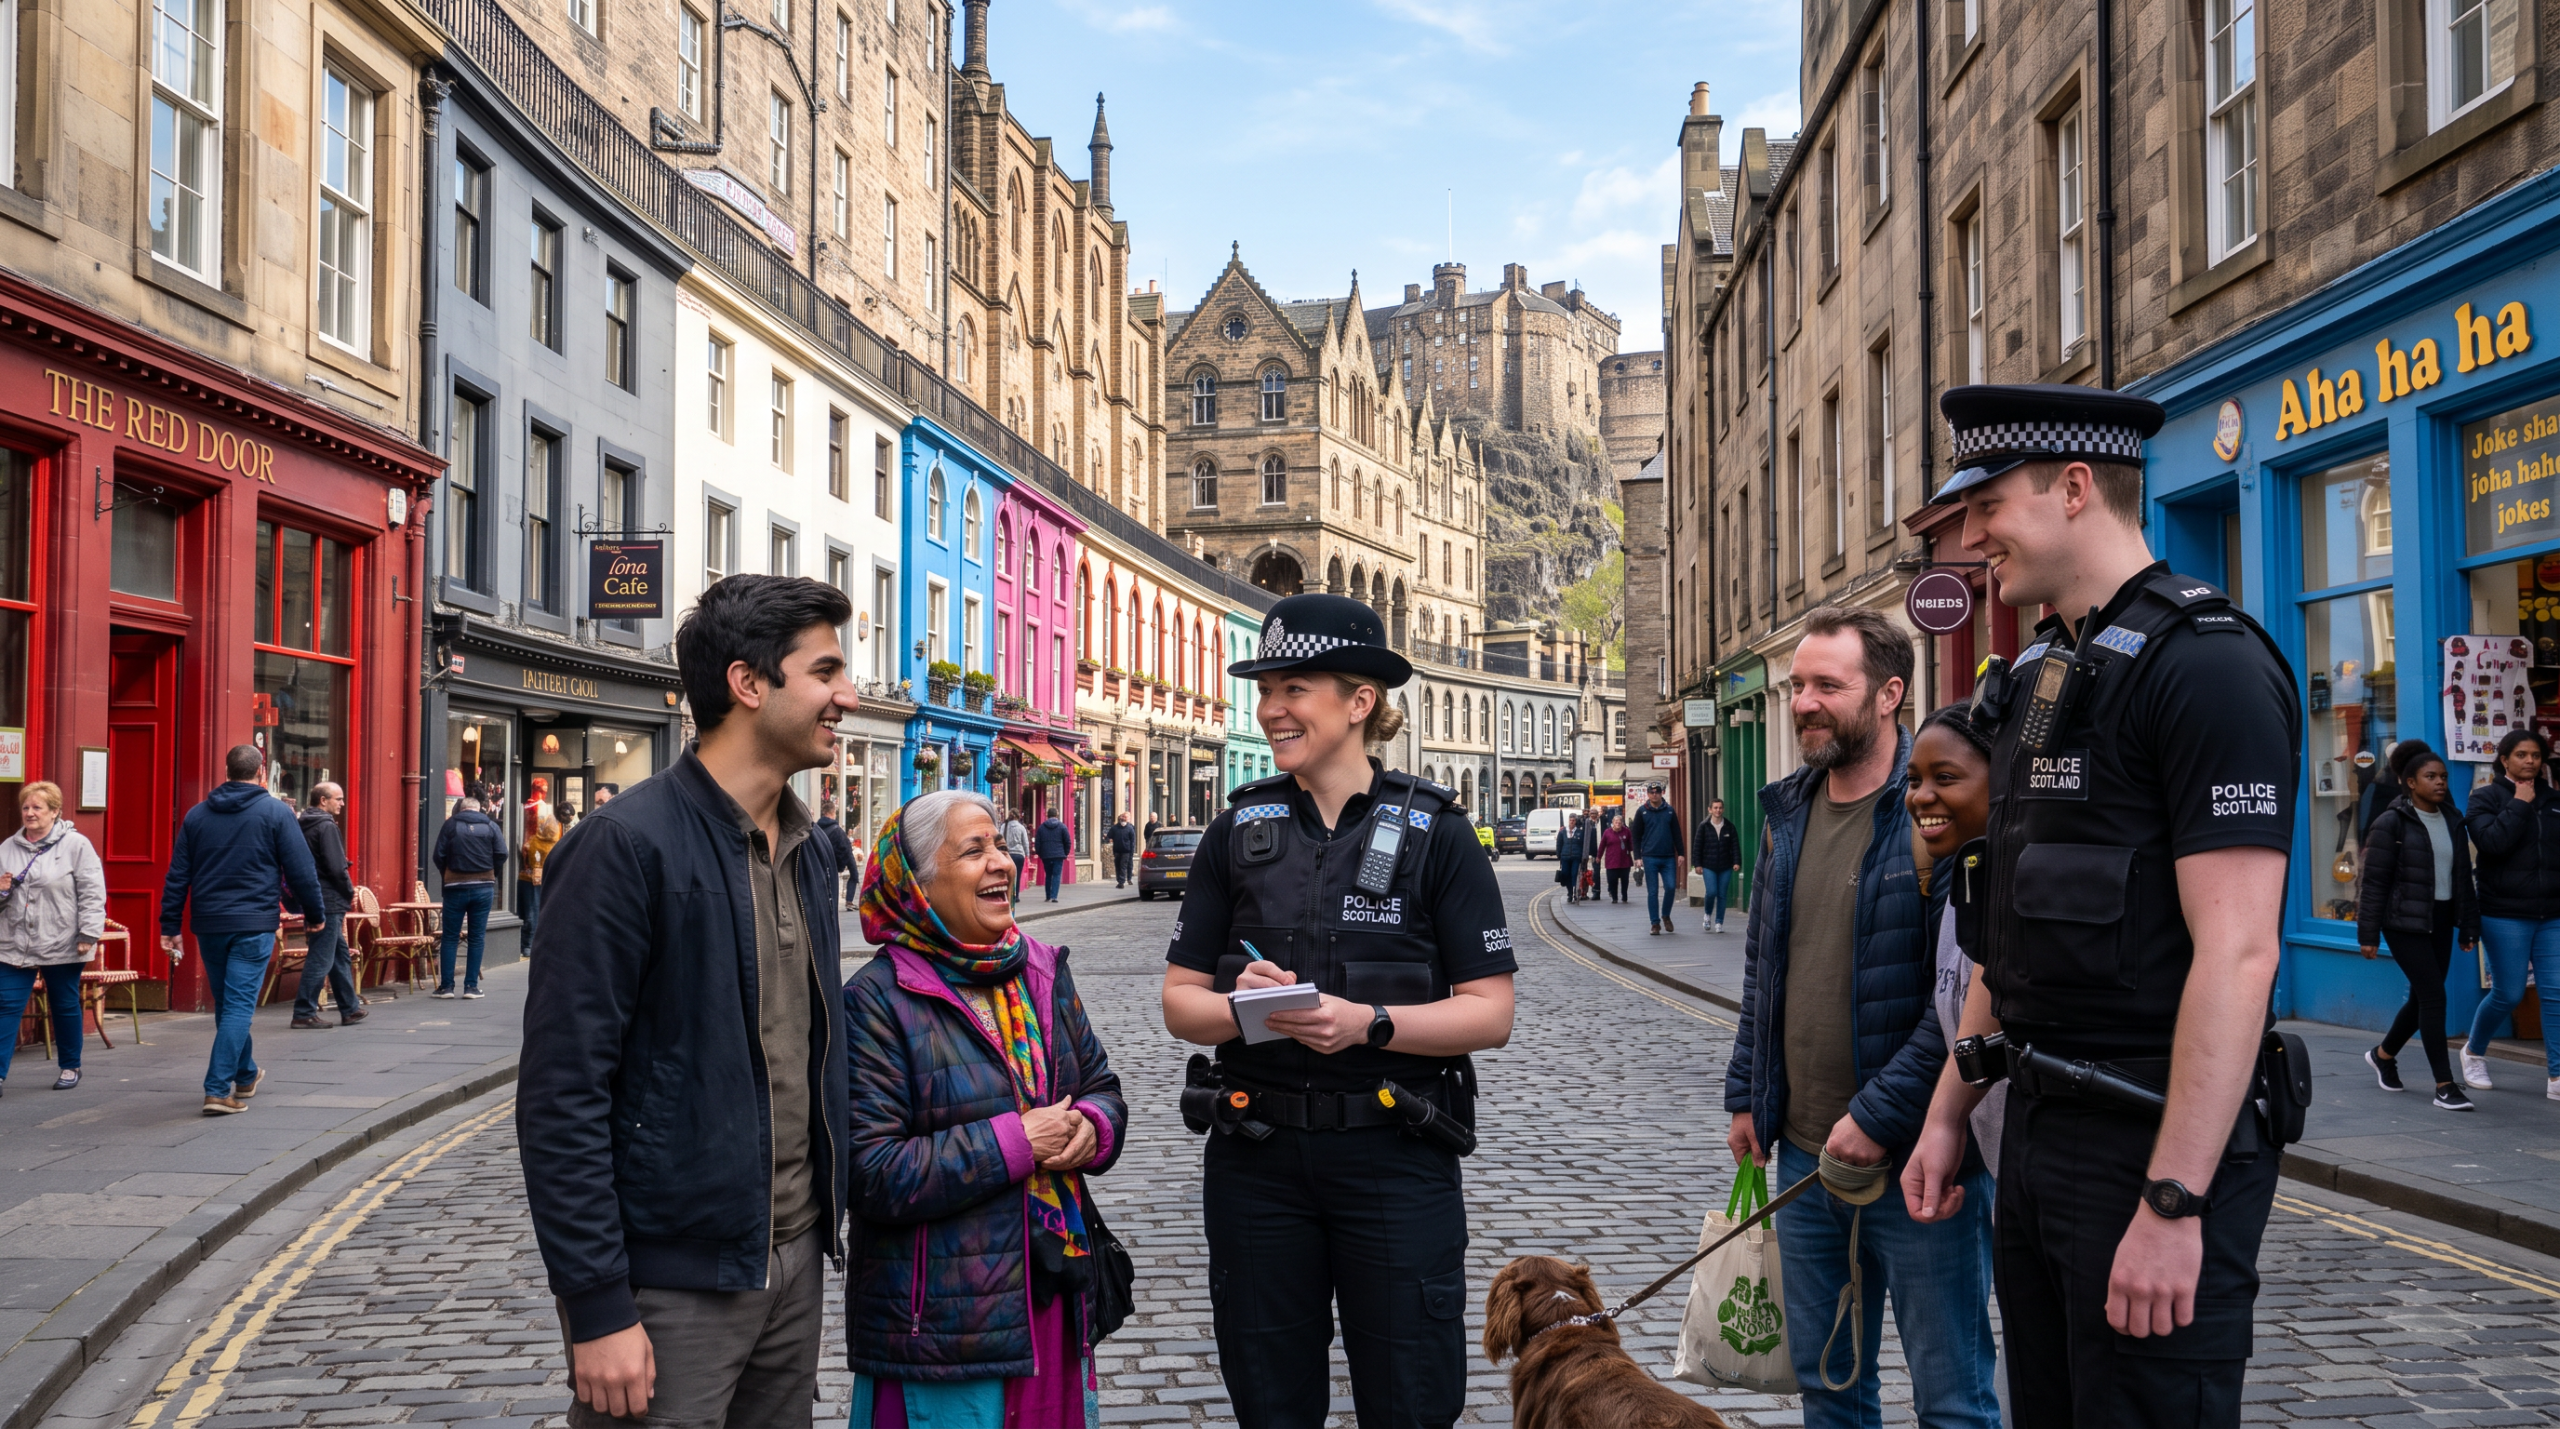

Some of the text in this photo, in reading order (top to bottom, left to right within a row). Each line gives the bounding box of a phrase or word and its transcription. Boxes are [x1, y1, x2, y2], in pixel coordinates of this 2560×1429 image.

[2275, 301, 2533, 441] Aha ha ha
[45, 368, 276, 484] THE RED DOOR
[2471, 413, 2560, 459] Joke sha
[2471, 467, 2512, 503] joha
[2497, 498, 2550, 534] jokes
[603, 577, 649, 595] Cafe
[2032, 757, 2081, 774] POLICE
[2030, 774, 2080, 790] SCOTLAND
[2211, 783, 2276, 801] POLICE
[2212, 800, 2277, 816] SCOTLAND
[1343, 895, 1402, 912] POLICE
[1342, 909, 1401, 925] SCOTLAND
